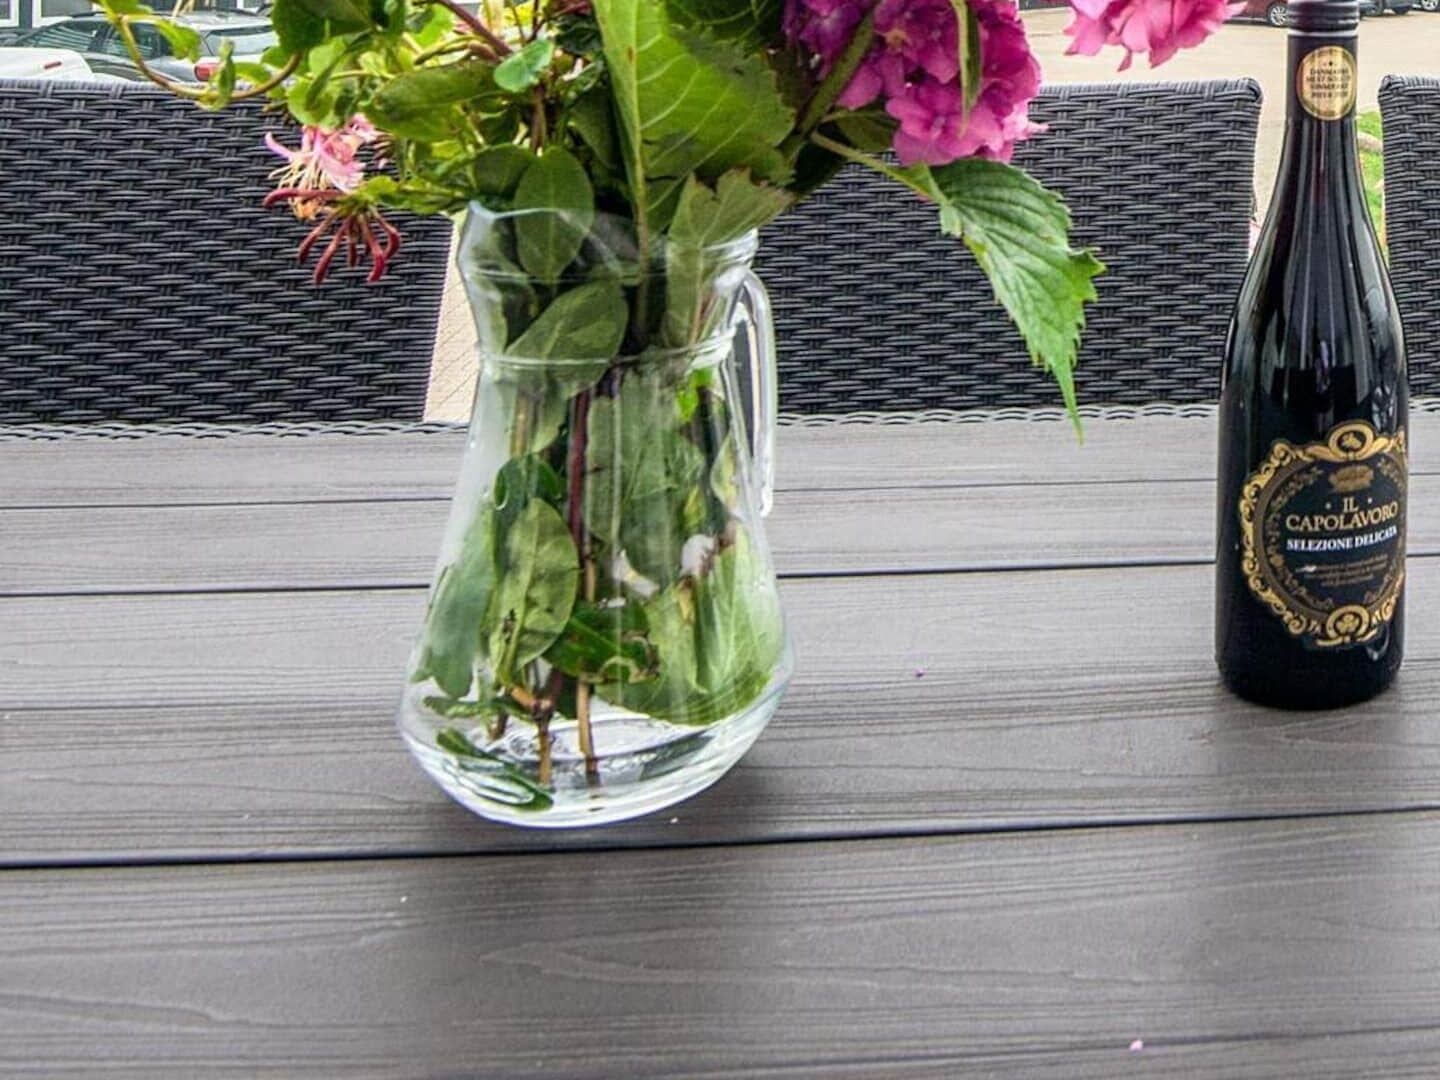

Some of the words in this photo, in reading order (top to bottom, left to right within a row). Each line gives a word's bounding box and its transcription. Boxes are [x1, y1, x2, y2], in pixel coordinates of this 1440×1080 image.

[1343, 497, 1359, 513] IL
[1286, 501, 1398, 532] CAPOLAVORO
[1286, 537, 1353, 551] SELEZIONE
